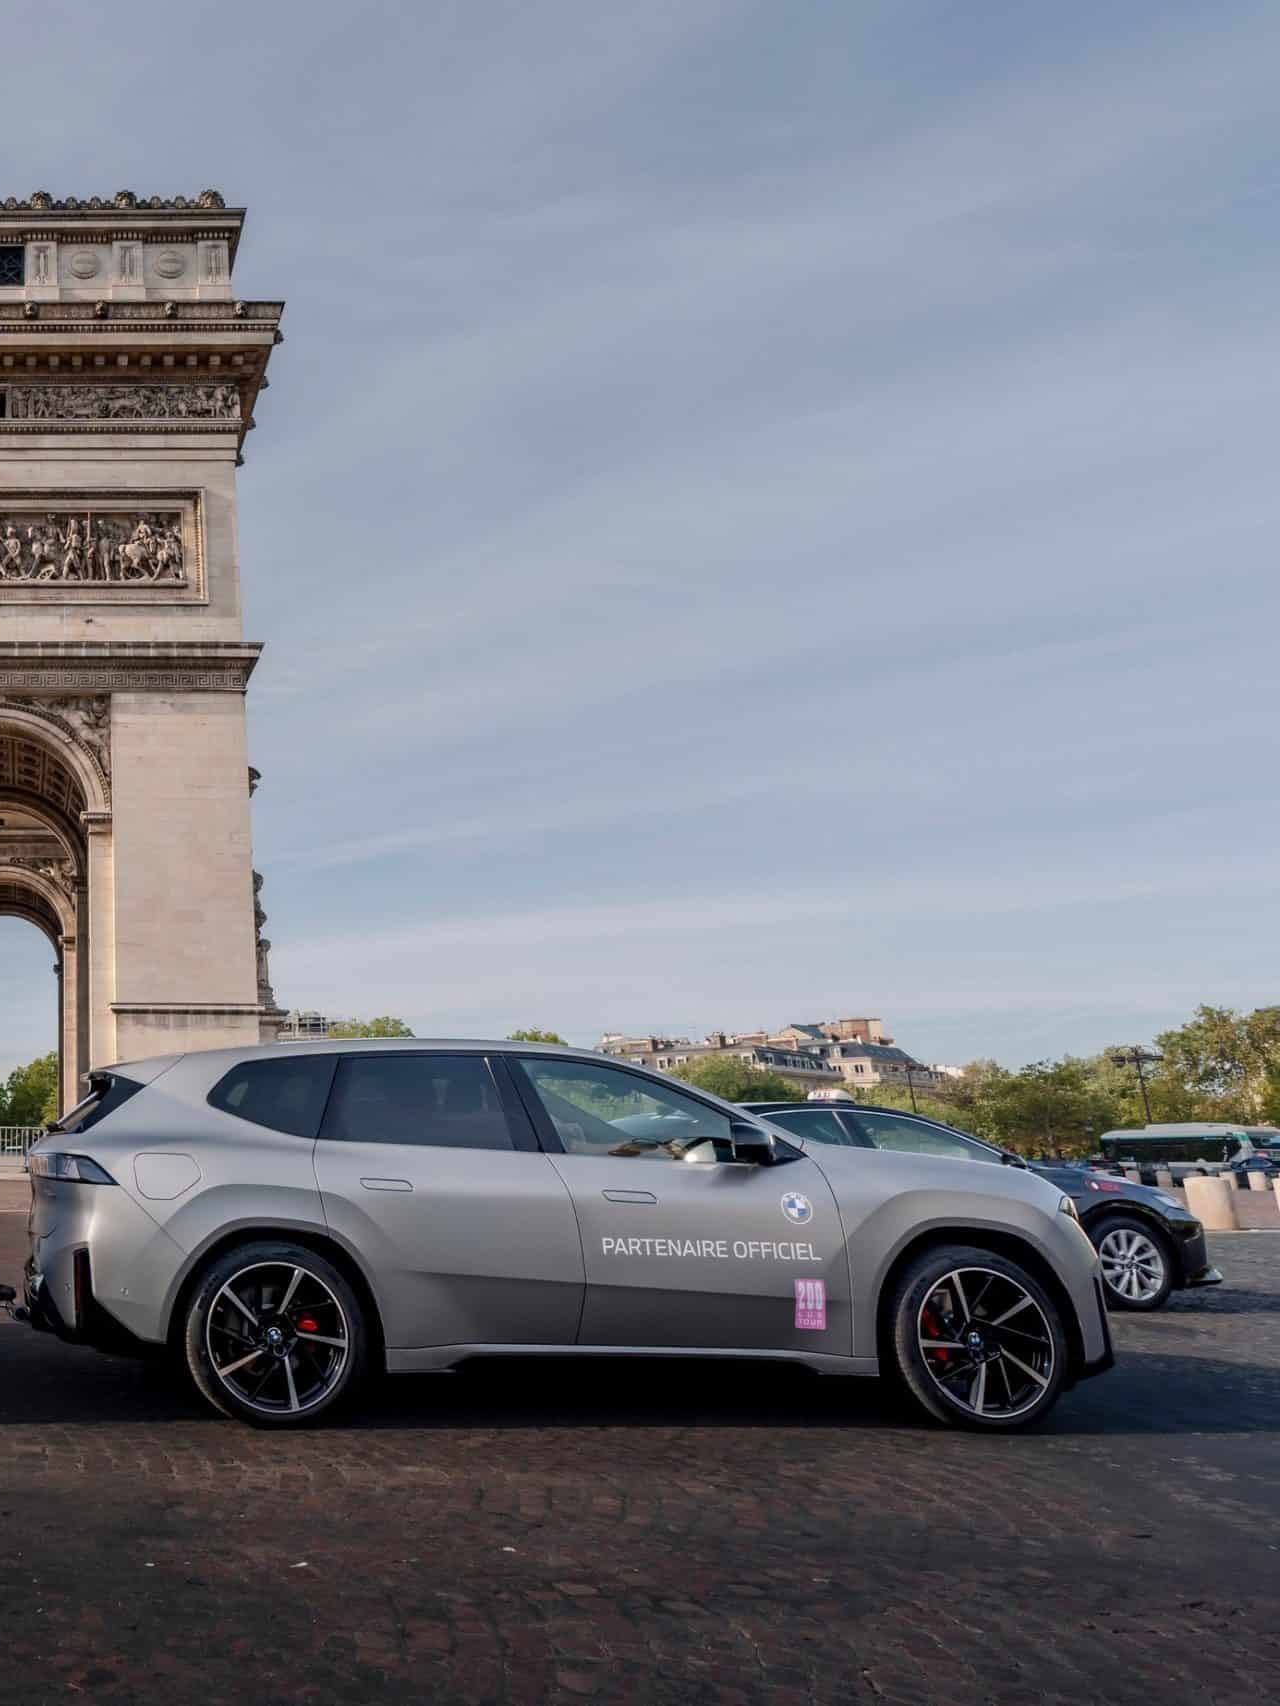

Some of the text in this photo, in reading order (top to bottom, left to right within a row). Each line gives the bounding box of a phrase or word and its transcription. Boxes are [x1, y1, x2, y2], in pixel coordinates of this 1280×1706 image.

[602, 1238, 822, 1261] PARTENAIRE OFFICIEL
[798, 1282, 823, 1310] 200
